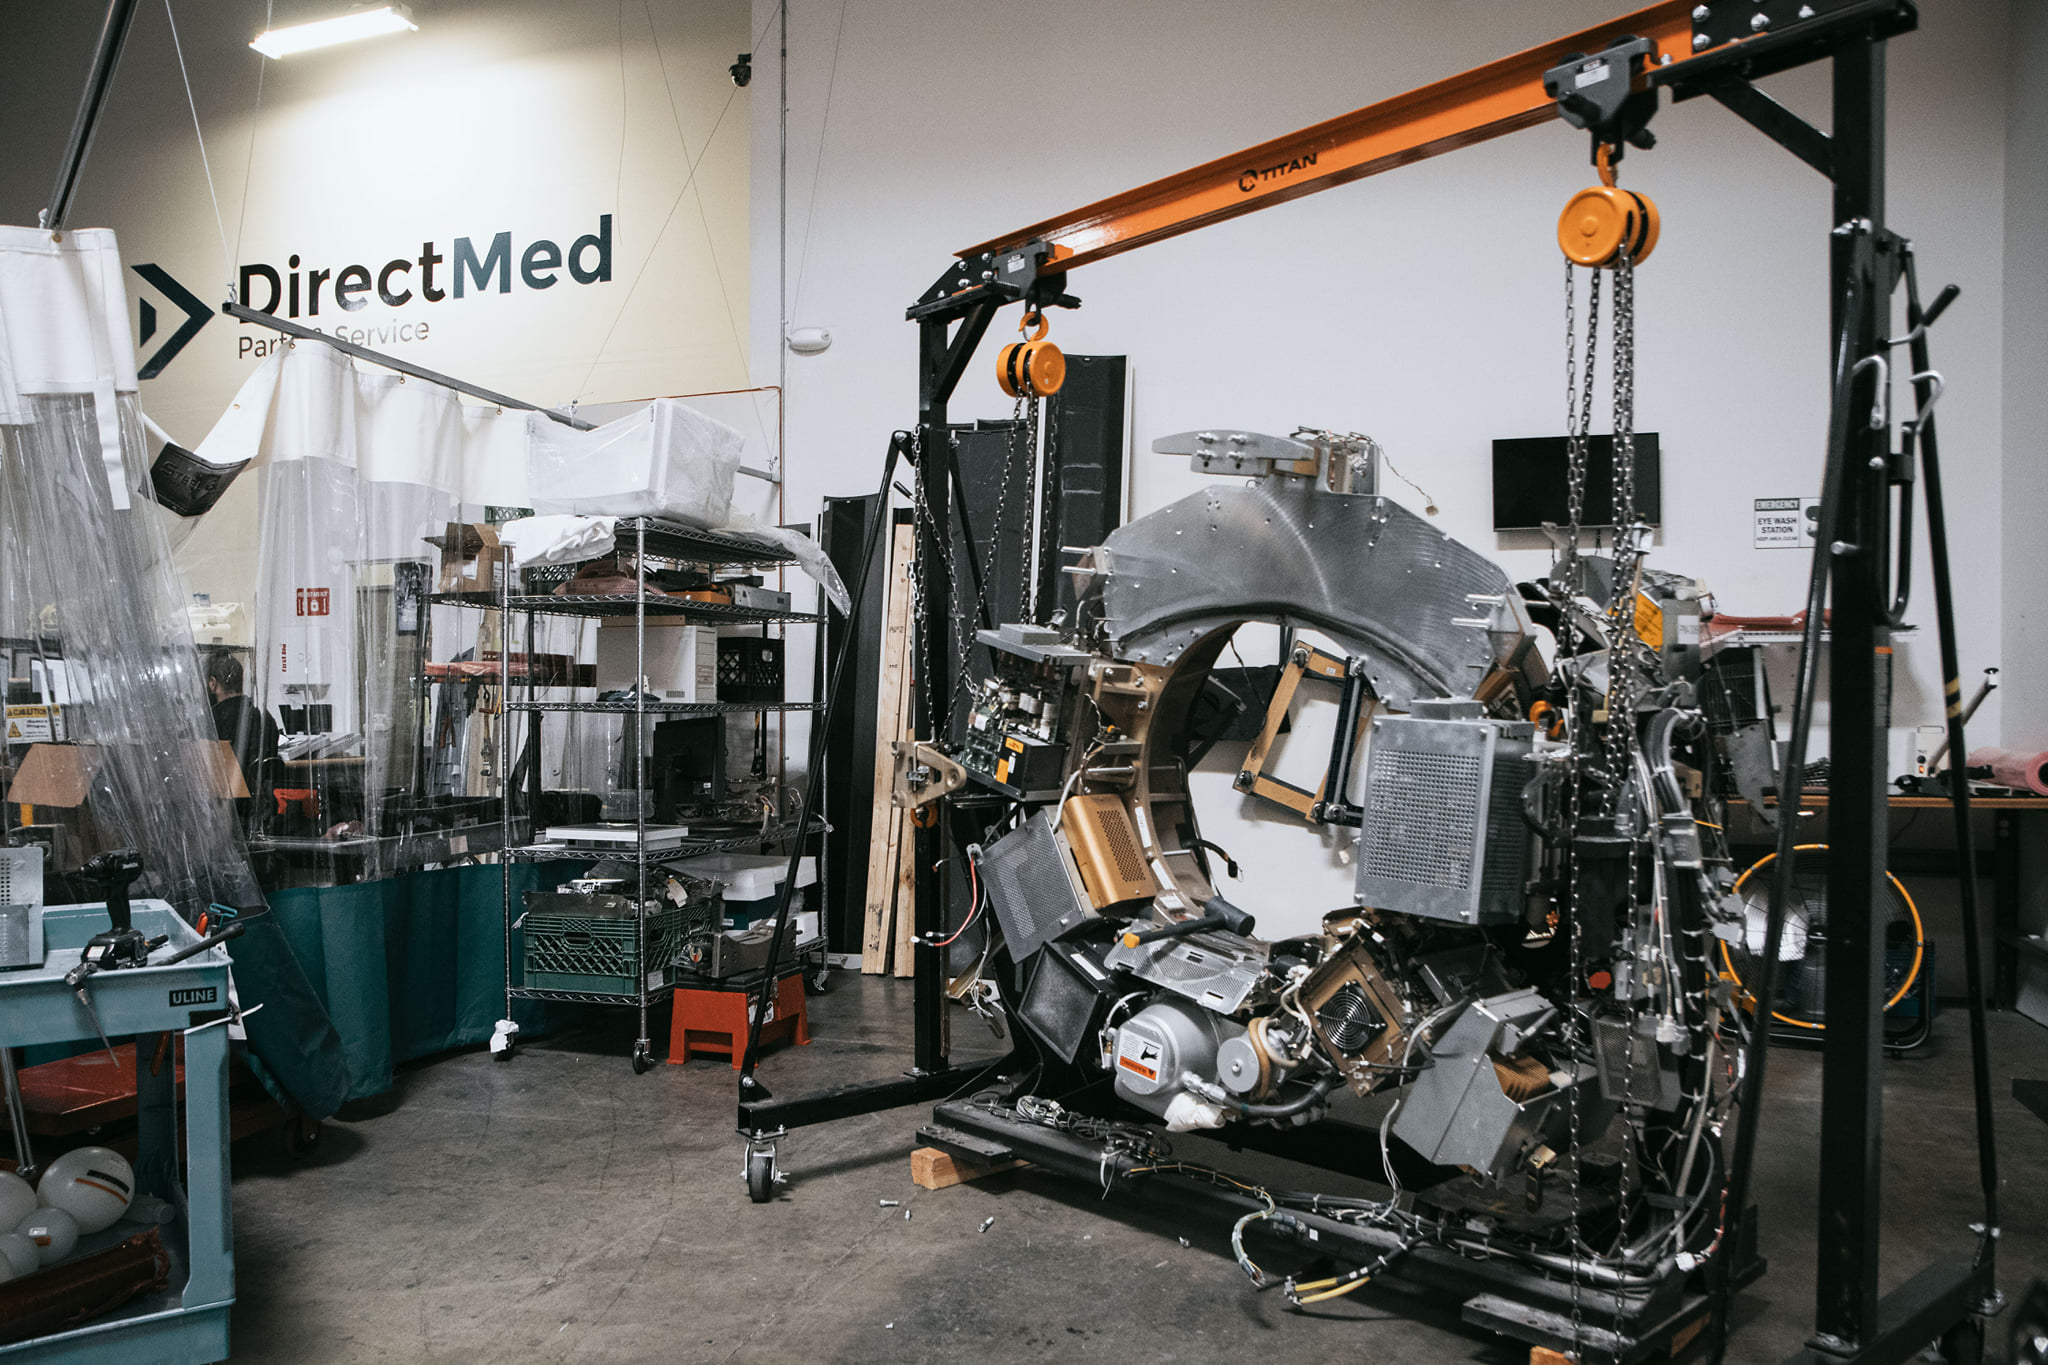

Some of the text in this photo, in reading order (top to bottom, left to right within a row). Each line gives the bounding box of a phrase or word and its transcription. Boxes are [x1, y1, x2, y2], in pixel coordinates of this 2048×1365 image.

[1260, 153, 1318, 181] TITAN
[238, 214, 612, 324] DirectMed
[239, 318, 430, 360] Part Service
[1761, 526, 1793, 534] STATION
[172, 989, 214, 1005] ULINE
